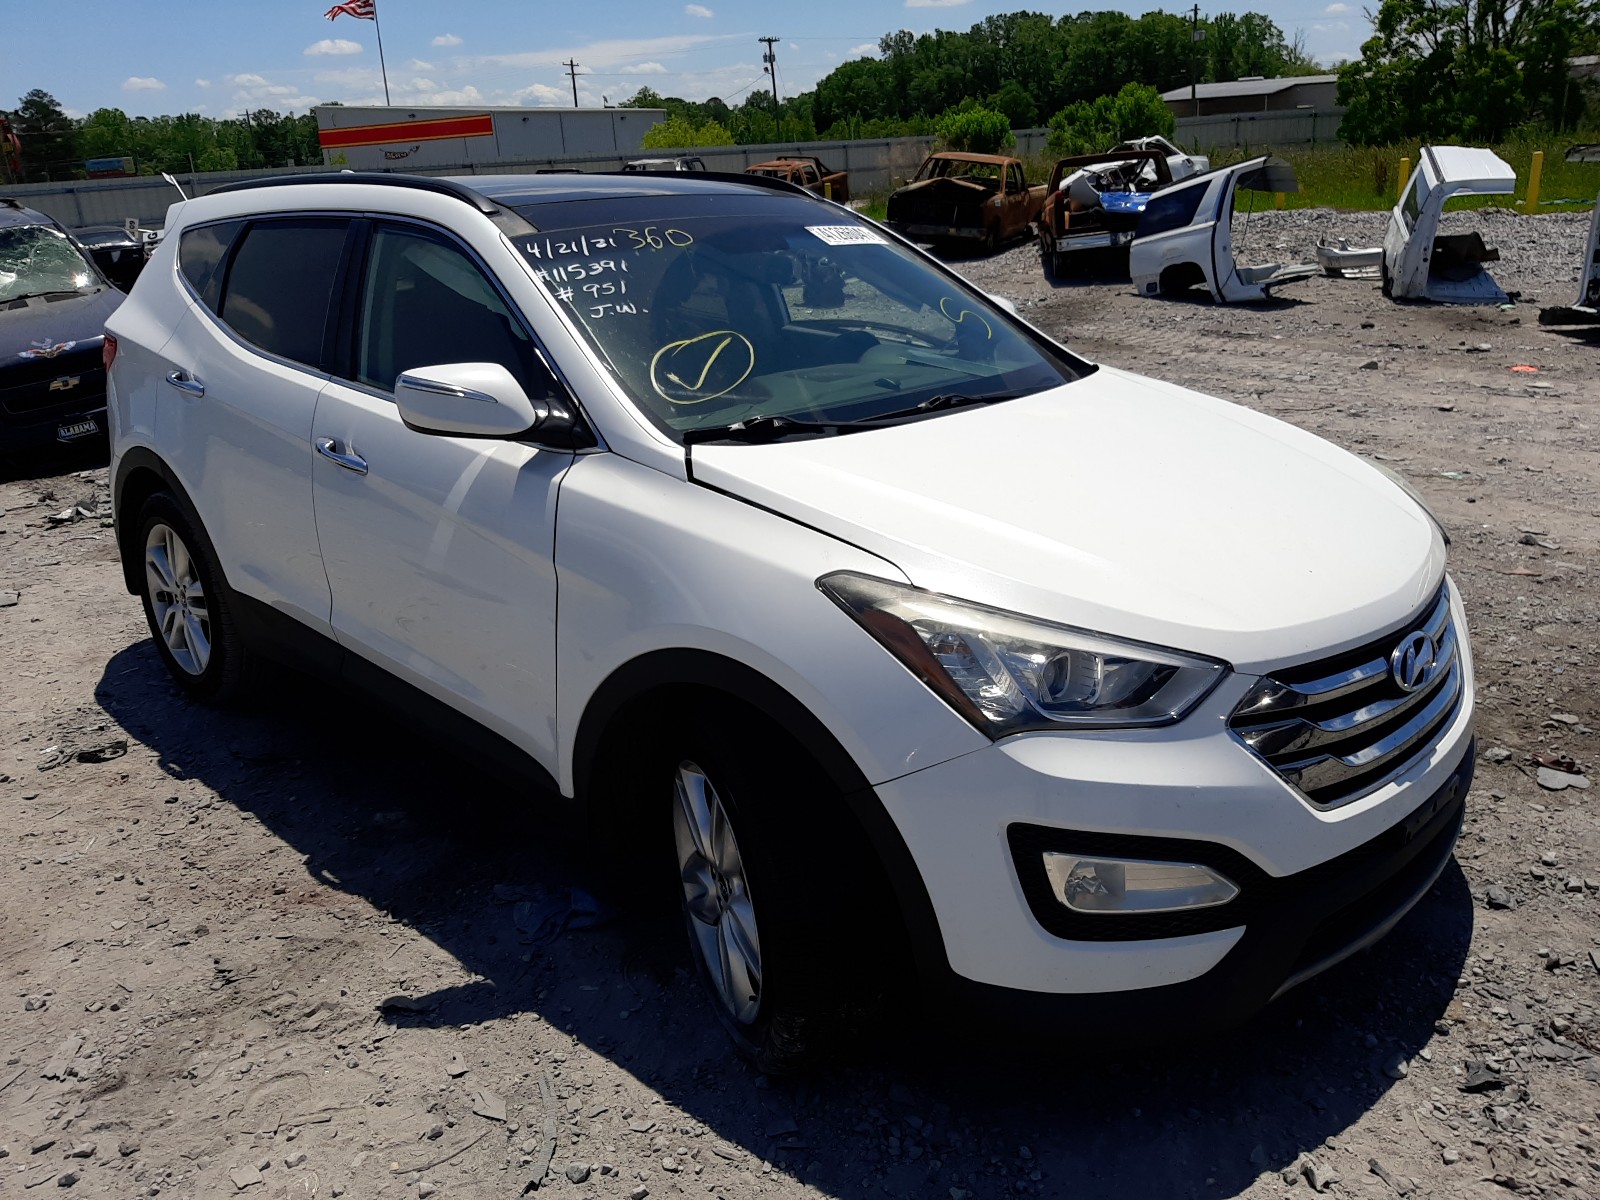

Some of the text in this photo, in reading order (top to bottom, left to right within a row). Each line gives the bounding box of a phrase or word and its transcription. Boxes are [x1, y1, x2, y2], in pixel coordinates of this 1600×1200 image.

[613, 227, 694, 249] 360
[535, 260, 628, 283] #115391
[60, 421, 96, 437] ALABAMA
